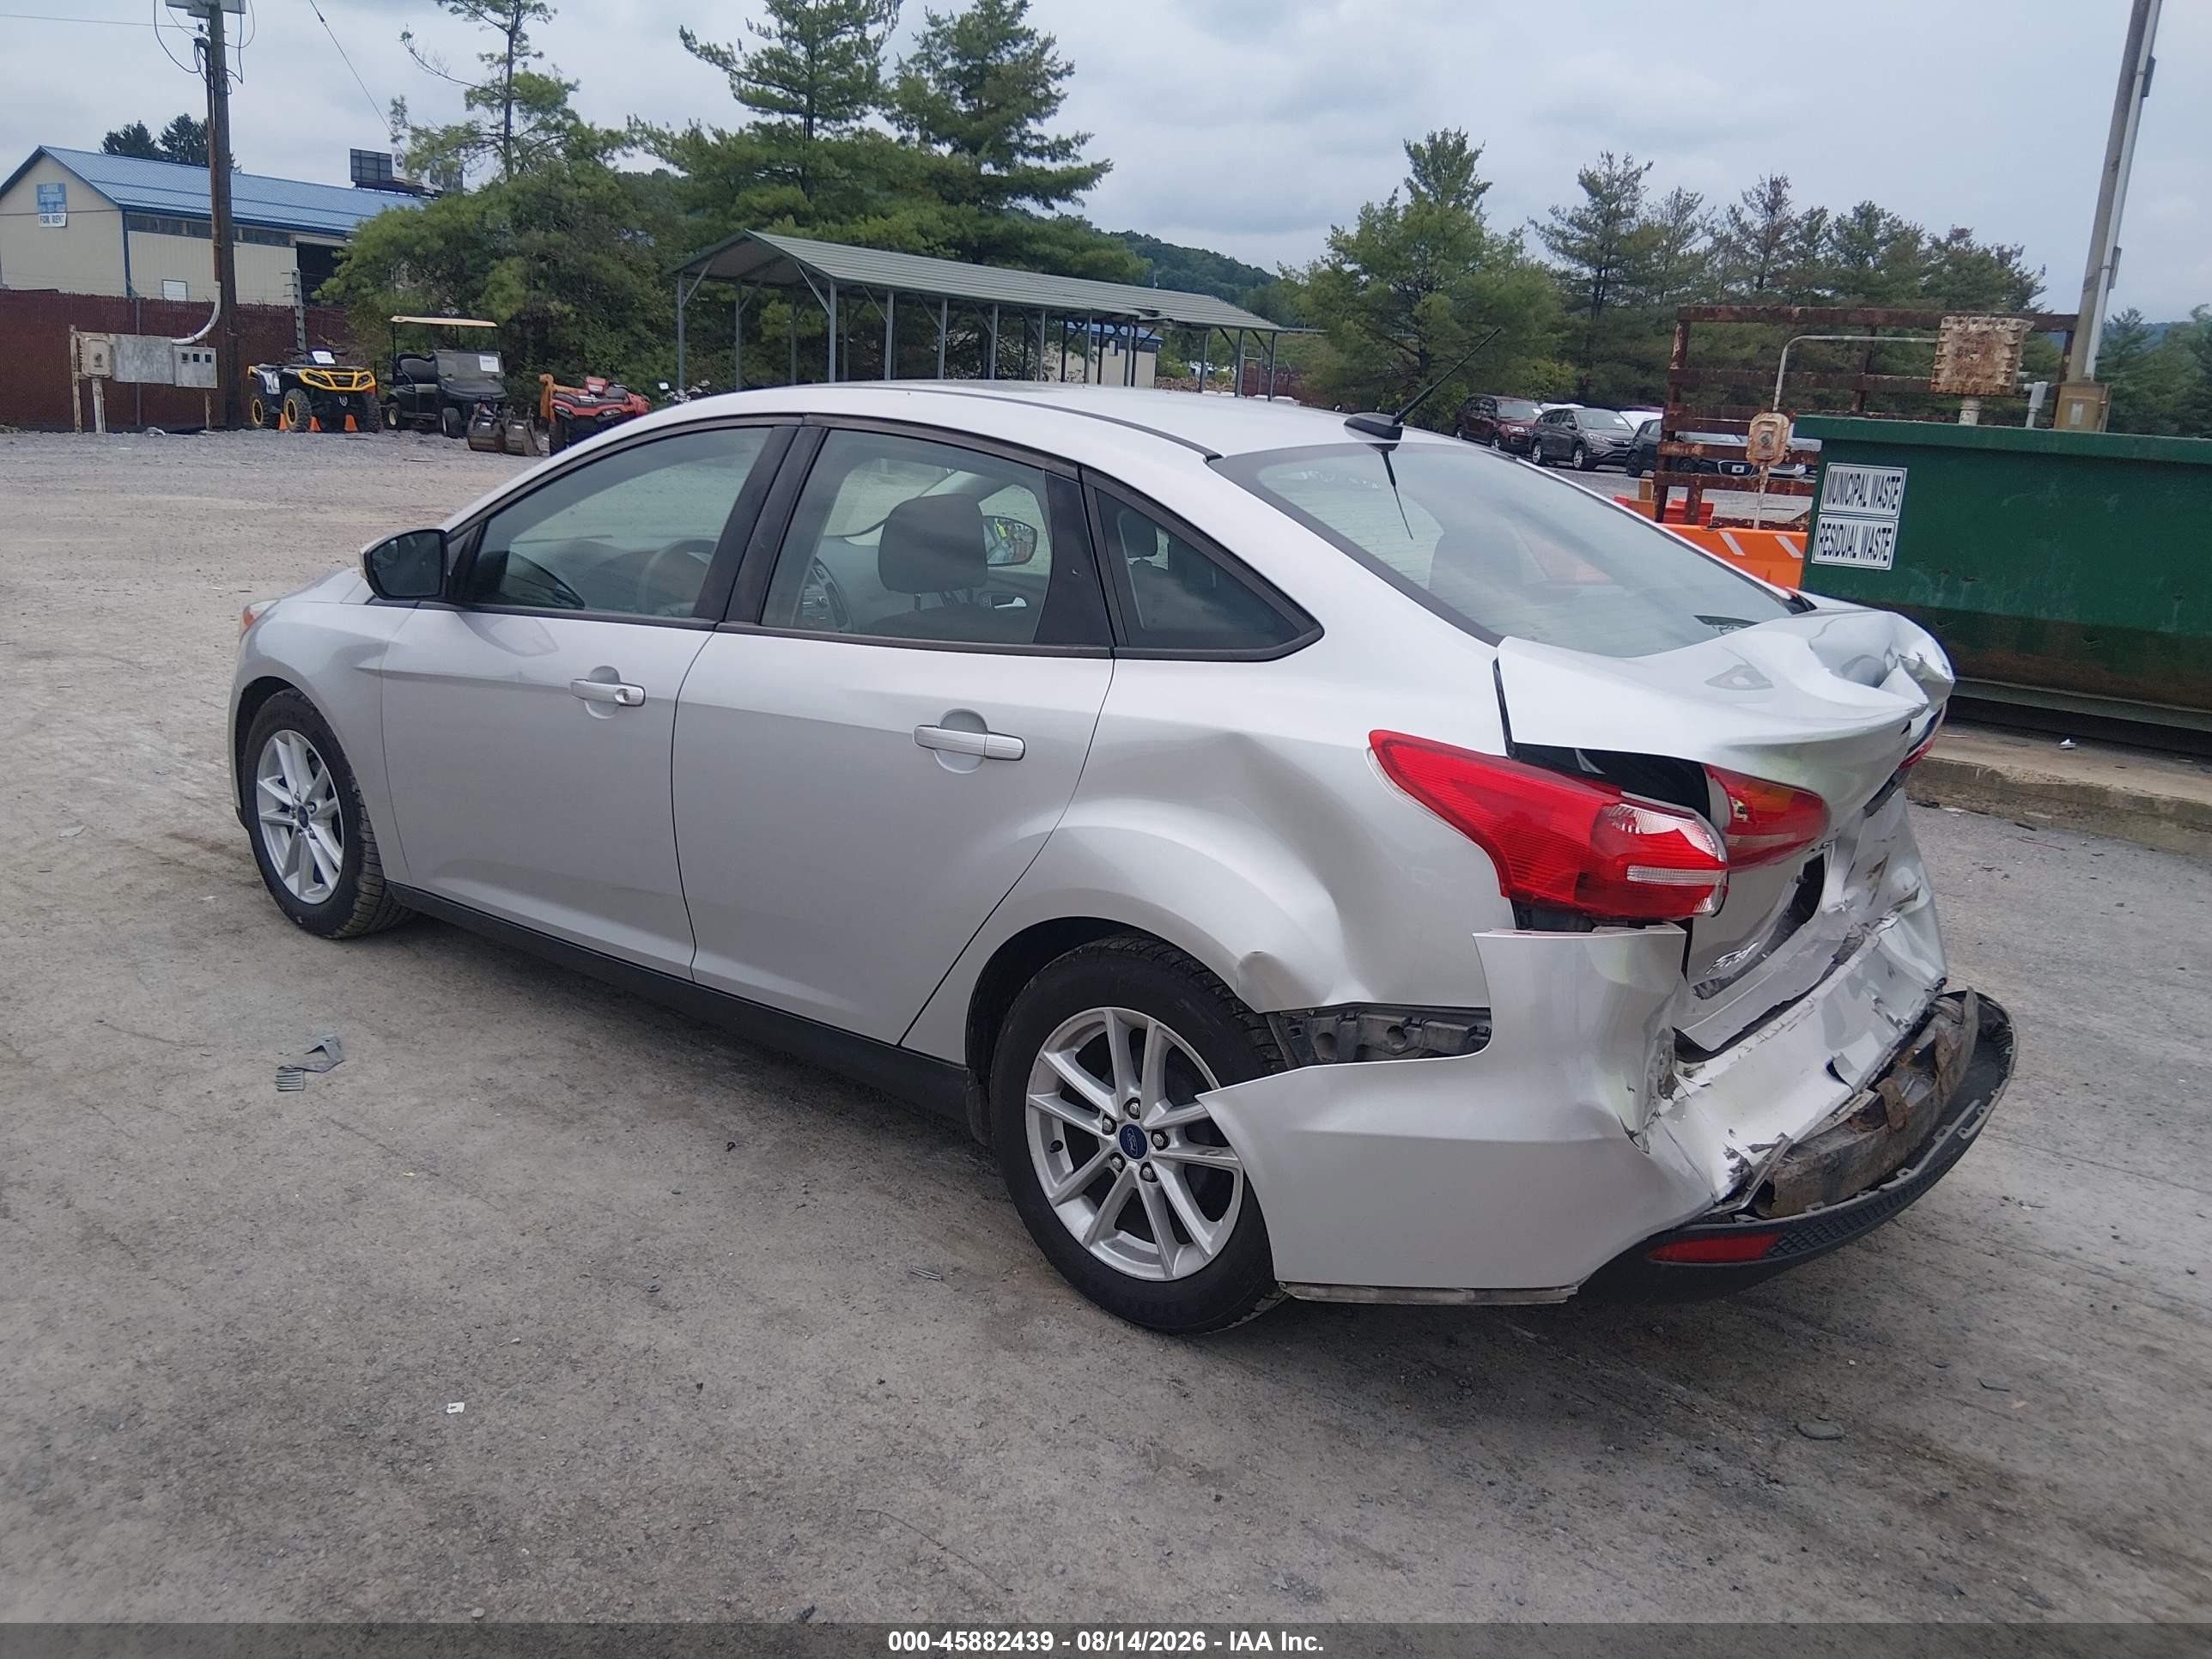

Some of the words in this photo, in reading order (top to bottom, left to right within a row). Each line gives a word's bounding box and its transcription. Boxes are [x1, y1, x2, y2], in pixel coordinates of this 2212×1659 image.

[40, 215, 50, 224] FOR
[1825, 471, 1869, 507] MUNICIPAL
[1869, 473, 1901, 510] WASTE
[1816, 522, 1859, 559] RESIDUAL
[1859, 526, 1893, 562] WASTE
